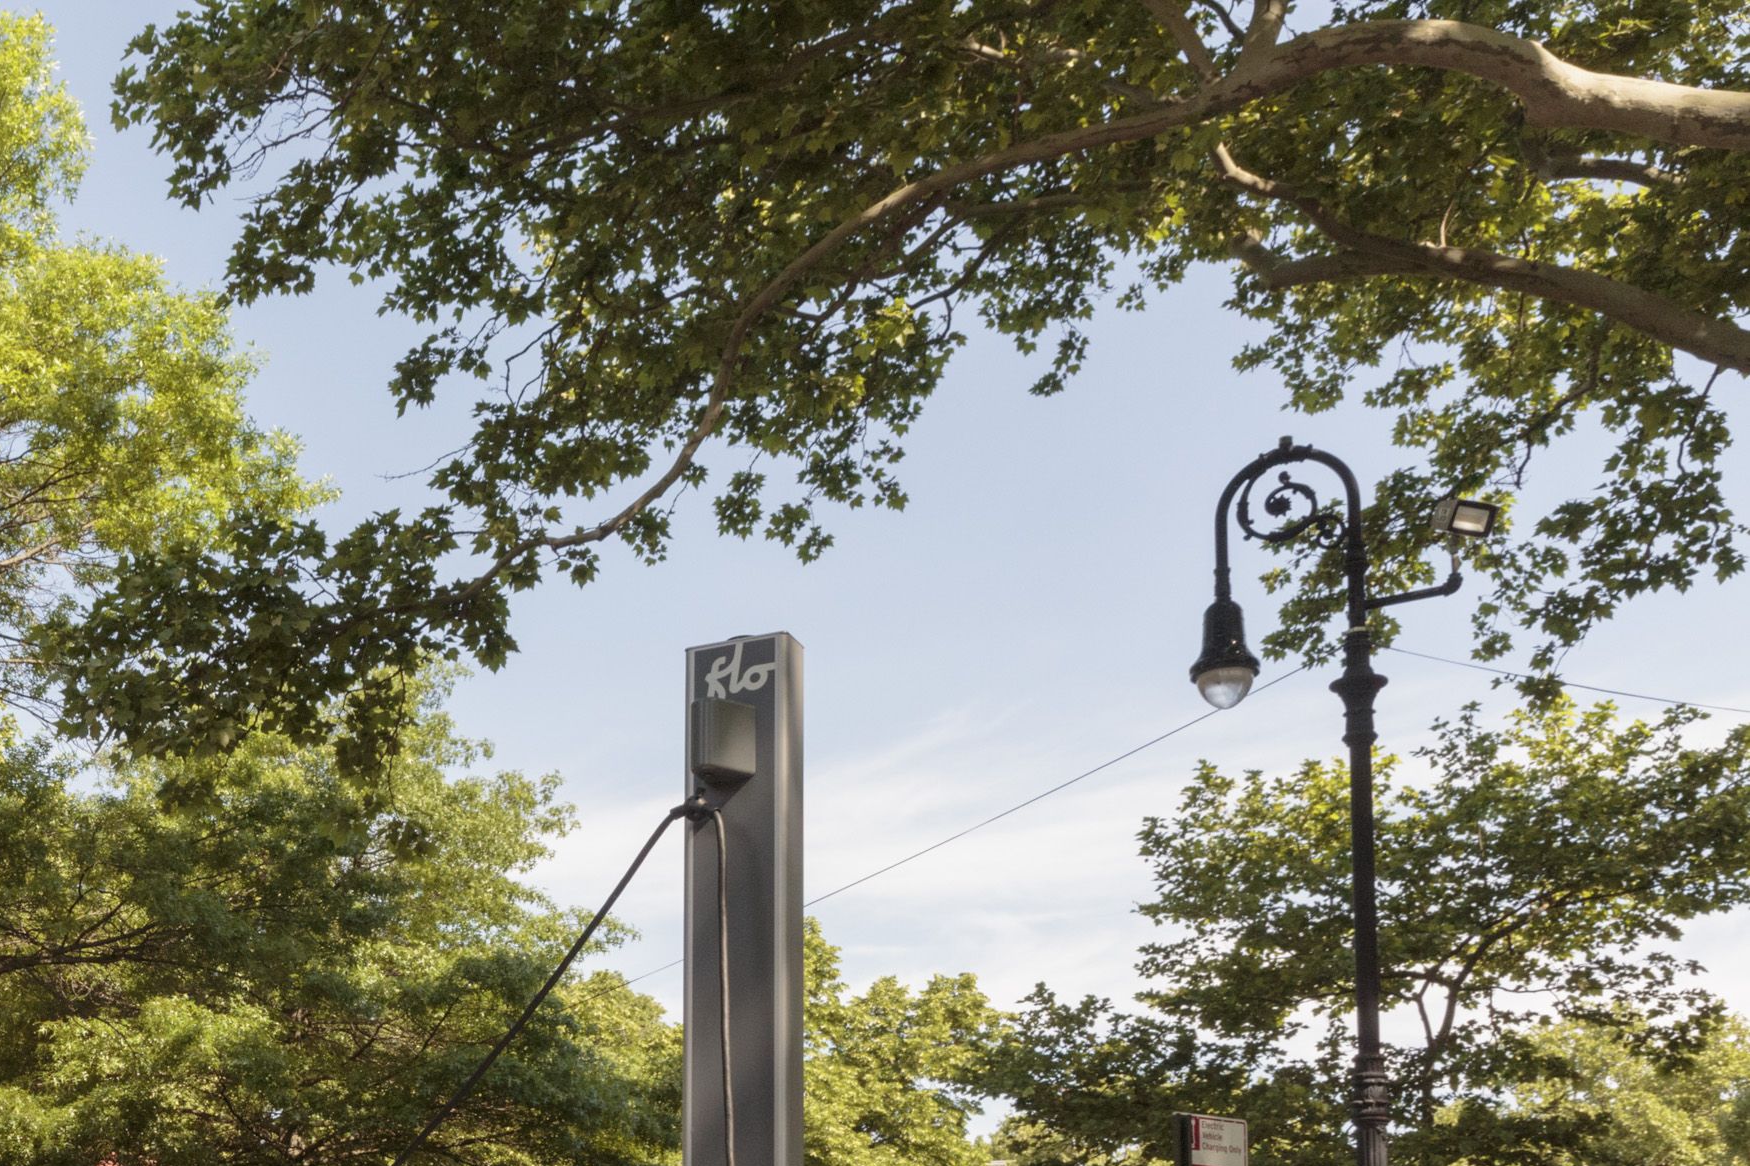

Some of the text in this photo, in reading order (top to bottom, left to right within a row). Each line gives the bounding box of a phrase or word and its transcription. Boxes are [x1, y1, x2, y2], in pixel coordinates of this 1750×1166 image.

[705, 642, 776, 700] flo
[1202, 1121, 1225, 1131] Electric
[1202, 1132, 1223, 1142] Vehicle
[1202, 1143, 1242, 1156] Charging Only
